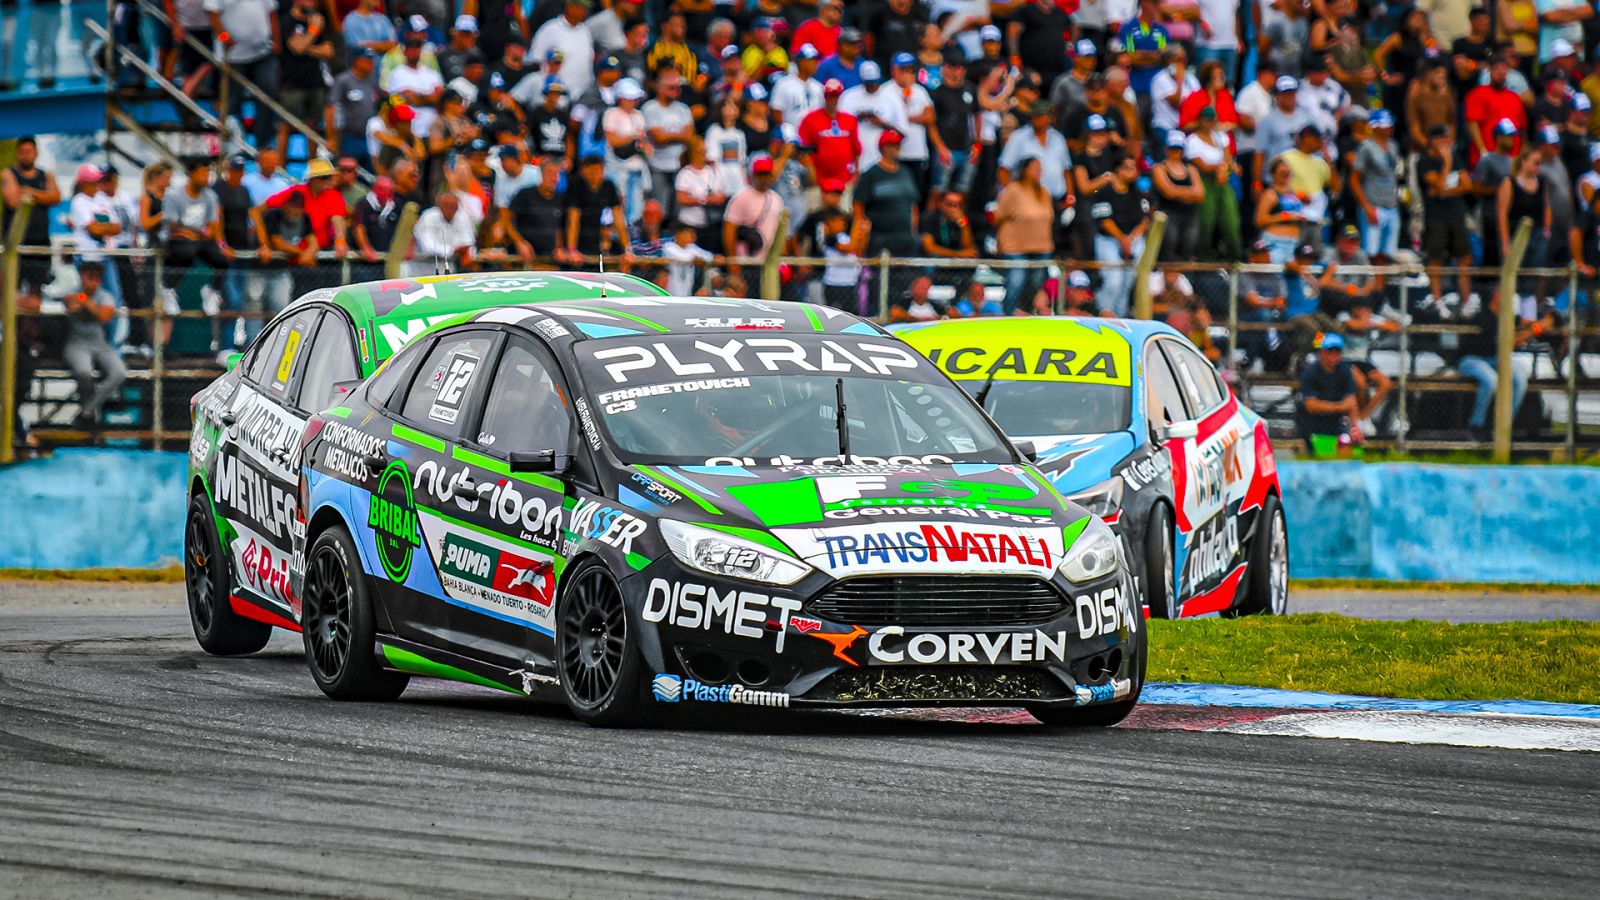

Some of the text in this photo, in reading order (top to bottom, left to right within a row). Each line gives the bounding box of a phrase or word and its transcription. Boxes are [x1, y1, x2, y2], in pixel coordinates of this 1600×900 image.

[277, 329, 300, 383] 8
[593, 338, 918, 384] PLYRAP
[437, 359, 477, 404] 12
[598, 377, 751, 404] FRANETOVICH
[605, 400, 637, 415] C3
[323, 420, 387, 459] CONFORMADOS
[323, 446, 369, 482] METALICOS
[369, 494, 420, 546] BRIBAL
[413, 460, 563, 541] nutribon
[823, 504, 1056, 525] General Paz
[520, 530, 533, 540] Les
[533, 534, 551, 546] hace
[569, 497, 647, 555] VASSER
[444, 543, 491, 579] PUMA
[723, 547, 760, 569] 12
[825, 524, 1053, 569] TRANSNATALI
[458, 581, 477, 596] BLANCA
[502, 595, 524, 610] TUERTO
[642, 578, 802, 654] DISMET
[868, 626, 1067, 665] CORVEN
[683, 681, 790, 709] PlastiGomm
